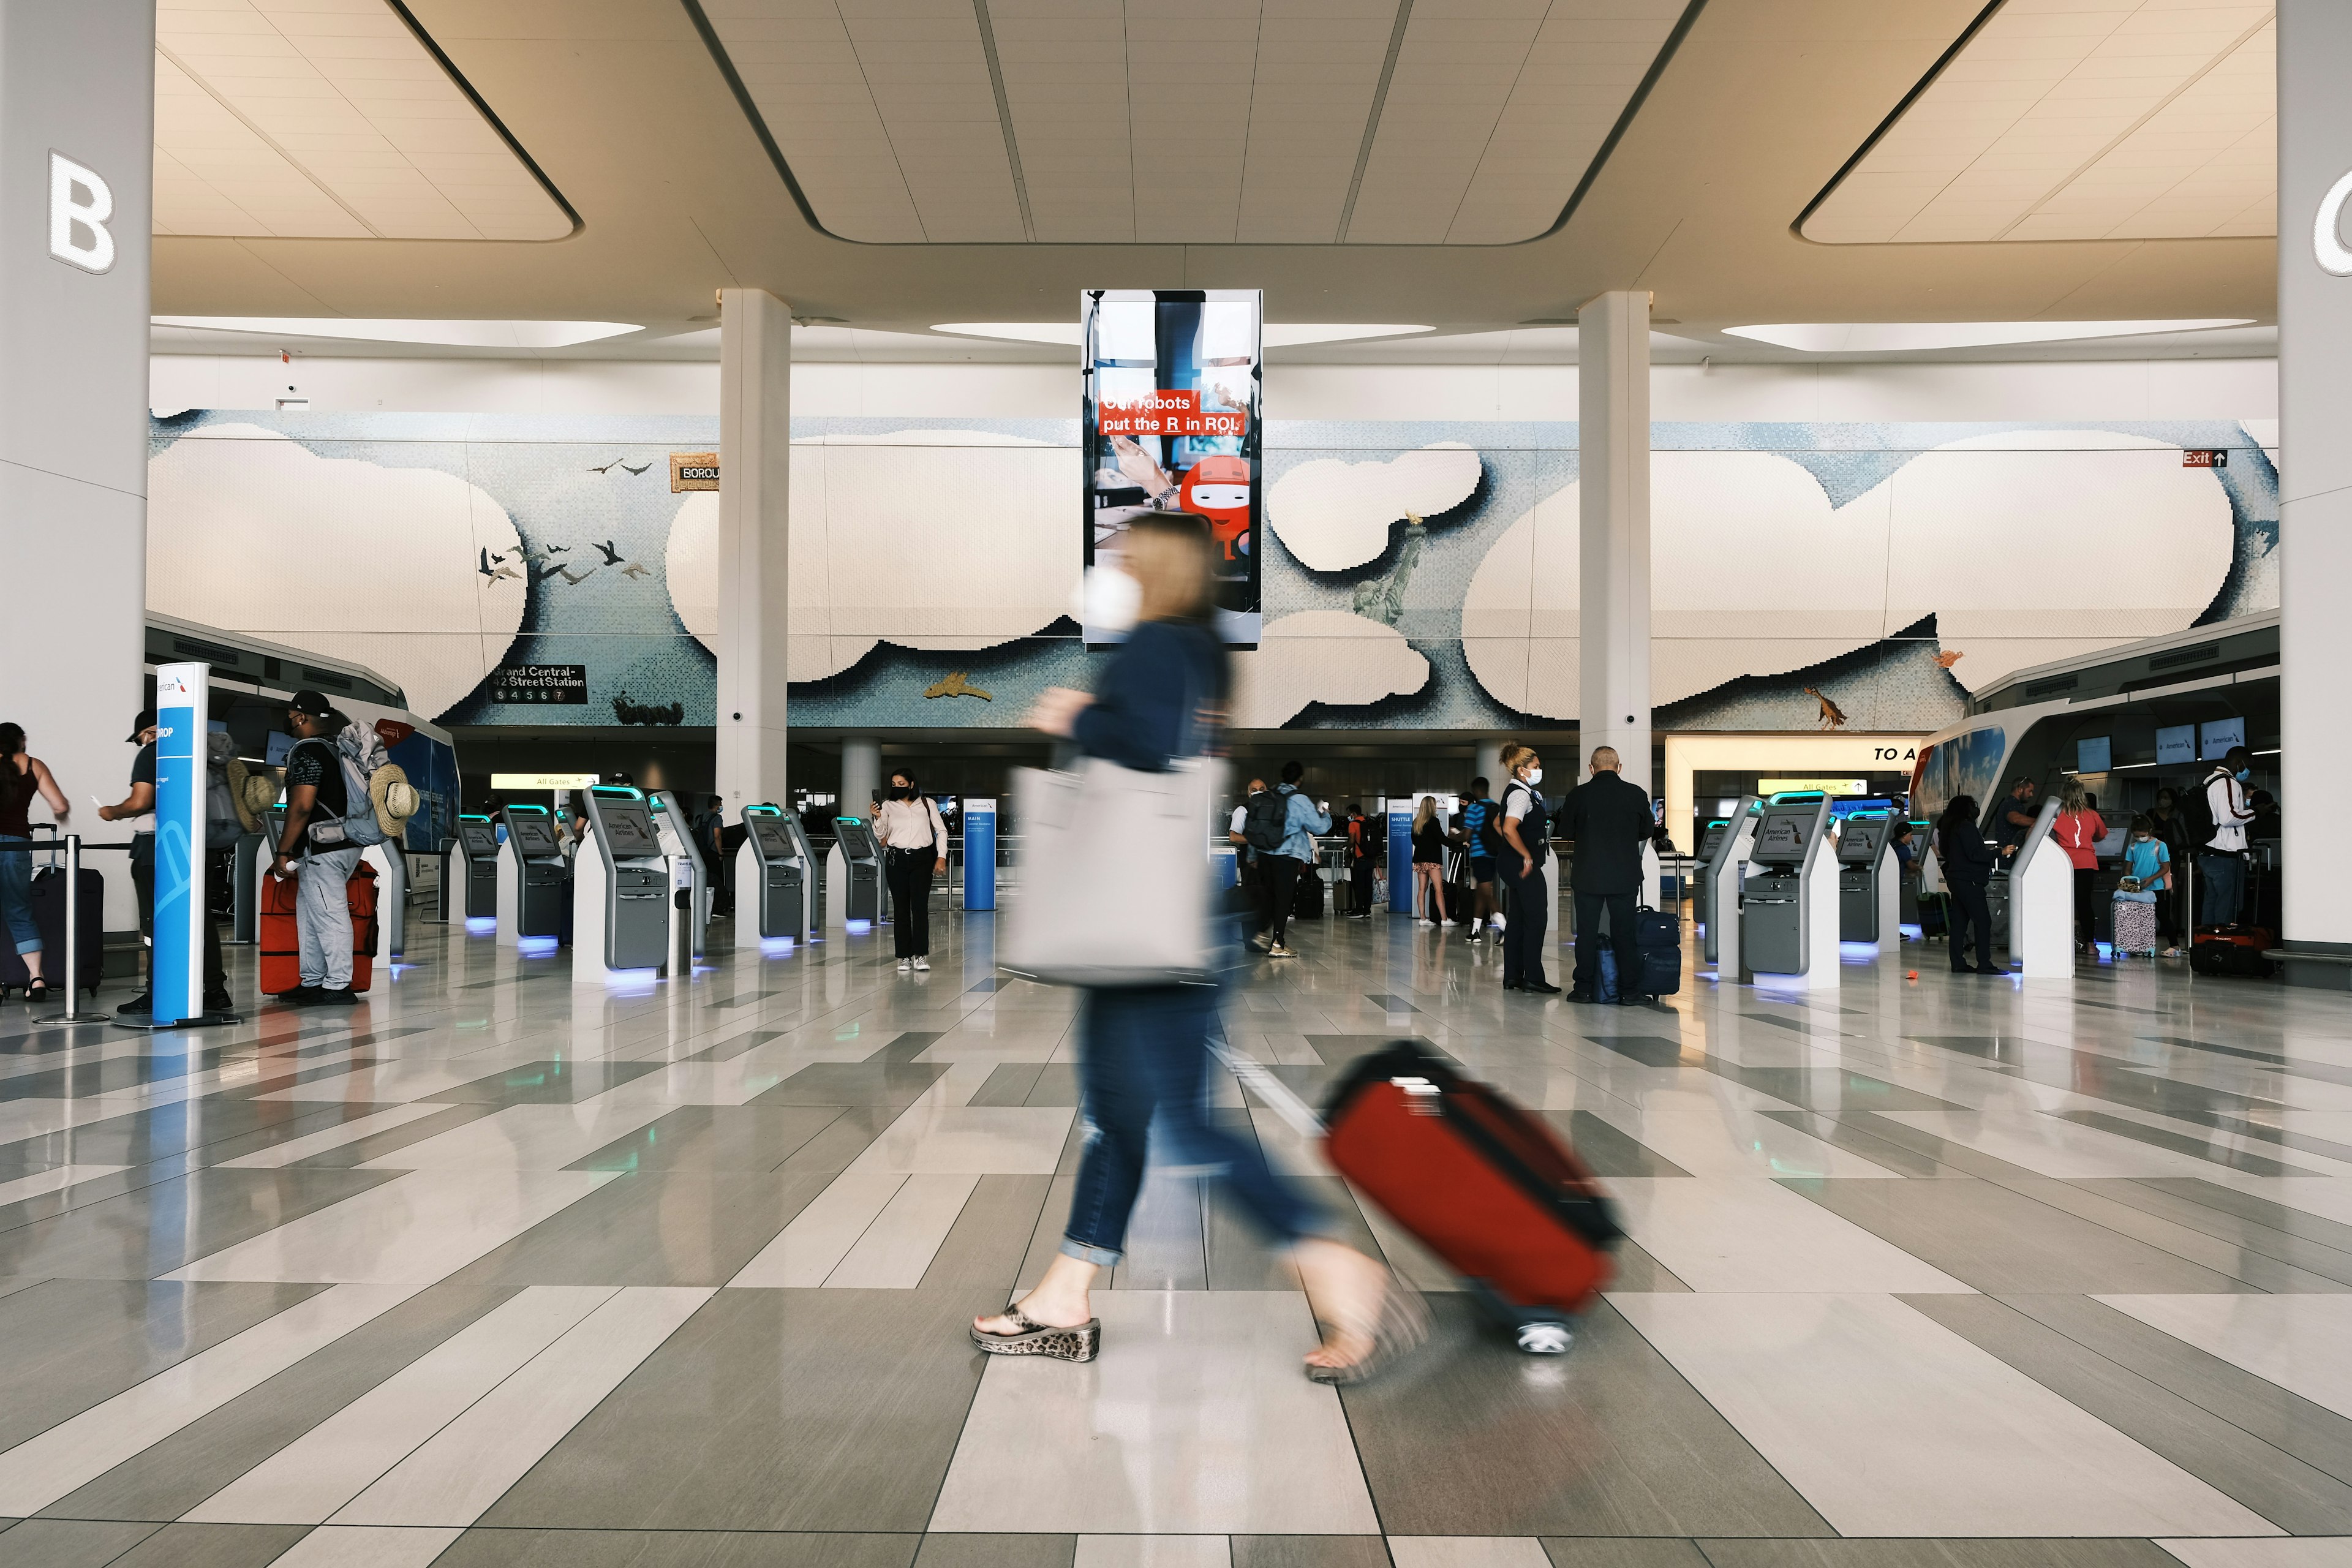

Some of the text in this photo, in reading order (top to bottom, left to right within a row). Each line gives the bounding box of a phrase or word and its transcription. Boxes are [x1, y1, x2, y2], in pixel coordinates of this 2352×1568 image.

[50, 152, 115, 271] B
[1138, 396, 1190, 410] robots
[1104, 417, 1240, 433] put the R in ROI.
[2183, 451, 2210, 464] Exit
[494, 666, 576, 677] Grand Central-
[157, 682, 175, 692] erican
[494, 676, 584, 687] 42 Street Station
[497, 691, 504, 699] S
[511, 691, 518, 699] 4
[526, 691, 533, 699] 5
[541, 691, 548, 699] 6
[157, 727, 173, 738] DROP
[2212, 736, 2233, 744] American
[1874, 748, 1898, 760] TO
[1902, 748, 1916, 760] A
